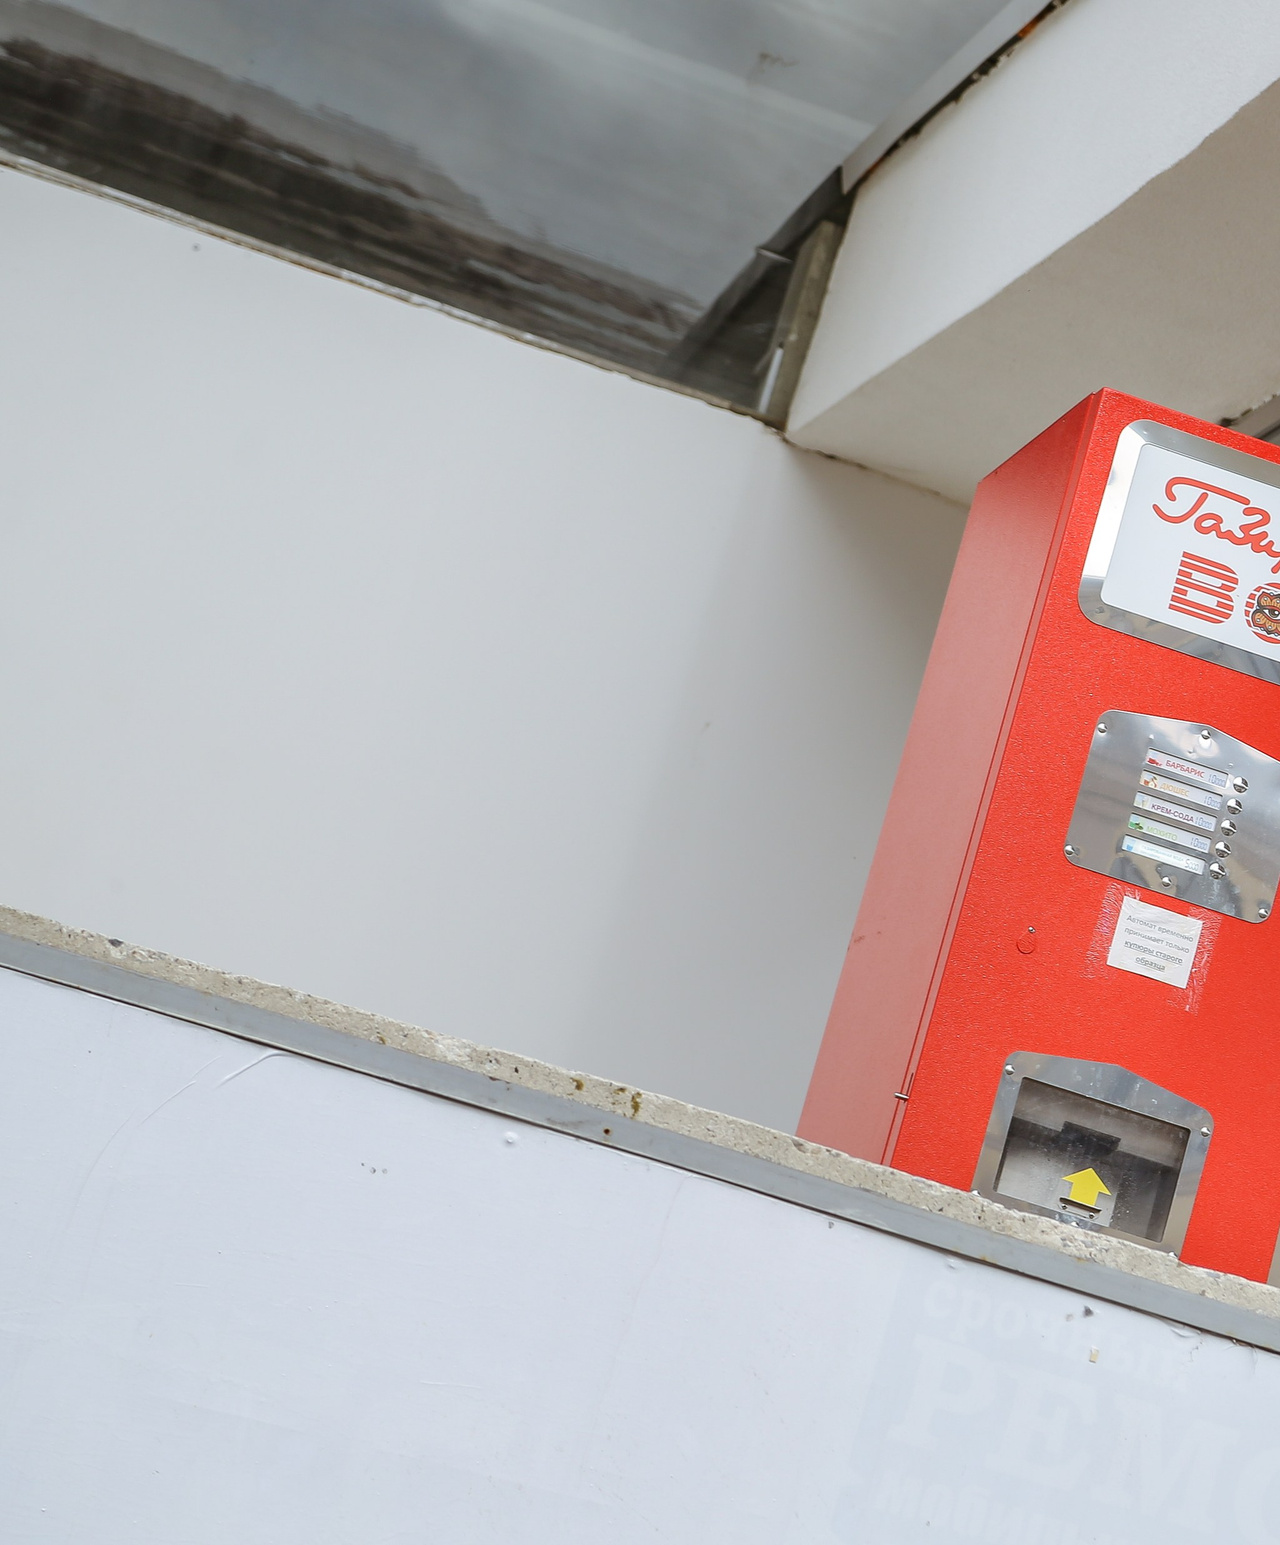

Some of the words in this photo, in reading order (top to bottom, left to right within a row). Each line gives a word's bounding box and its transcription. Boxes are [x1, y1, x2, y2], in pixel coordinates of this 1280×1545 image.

[1164, 759, 1205, 778] БАРБАРИС
[1159, 781, 1190, 797] ДЮШЕС
[1150, 803, 1195, 822] КРЕМ-СОДА
[1145, 825, 1178, 840] МОХИТО
[1126, 914, 1157, 929] Автомат
[1156, 926, 1194, 942] временно
[1123, 927, 1164, 944] принимает
[1164, 941, 1190, 953] только
[1123, 940, 1155, 954] купюры
[1154, 950, 1183, 964] старого
[1134, 955, 1166, 971] образца
